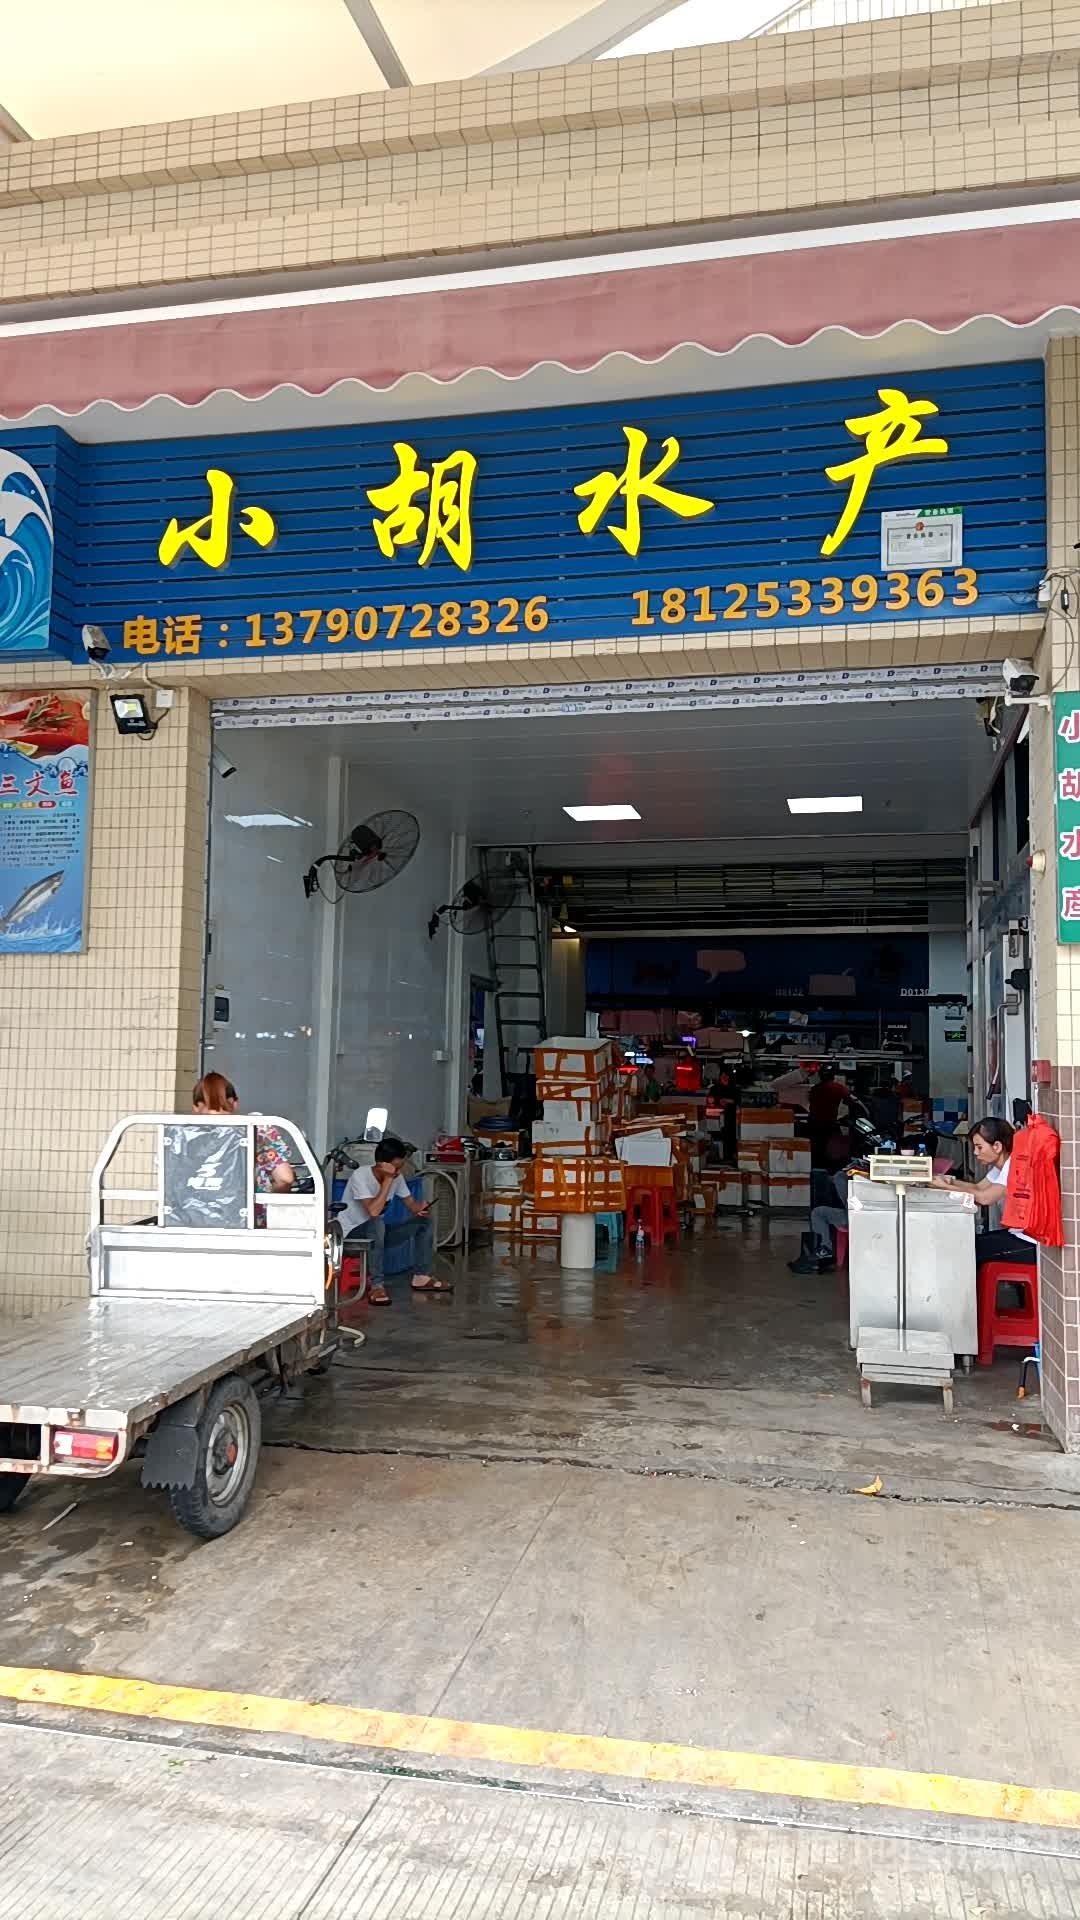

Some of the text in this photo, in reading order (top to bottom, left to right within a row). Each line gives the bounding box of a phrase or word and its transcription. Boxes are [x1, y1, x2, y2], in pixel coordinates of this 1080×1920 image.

[158, 388, 949, 570] 小胡水产
[631, 567, 979, 625] 18125339363
